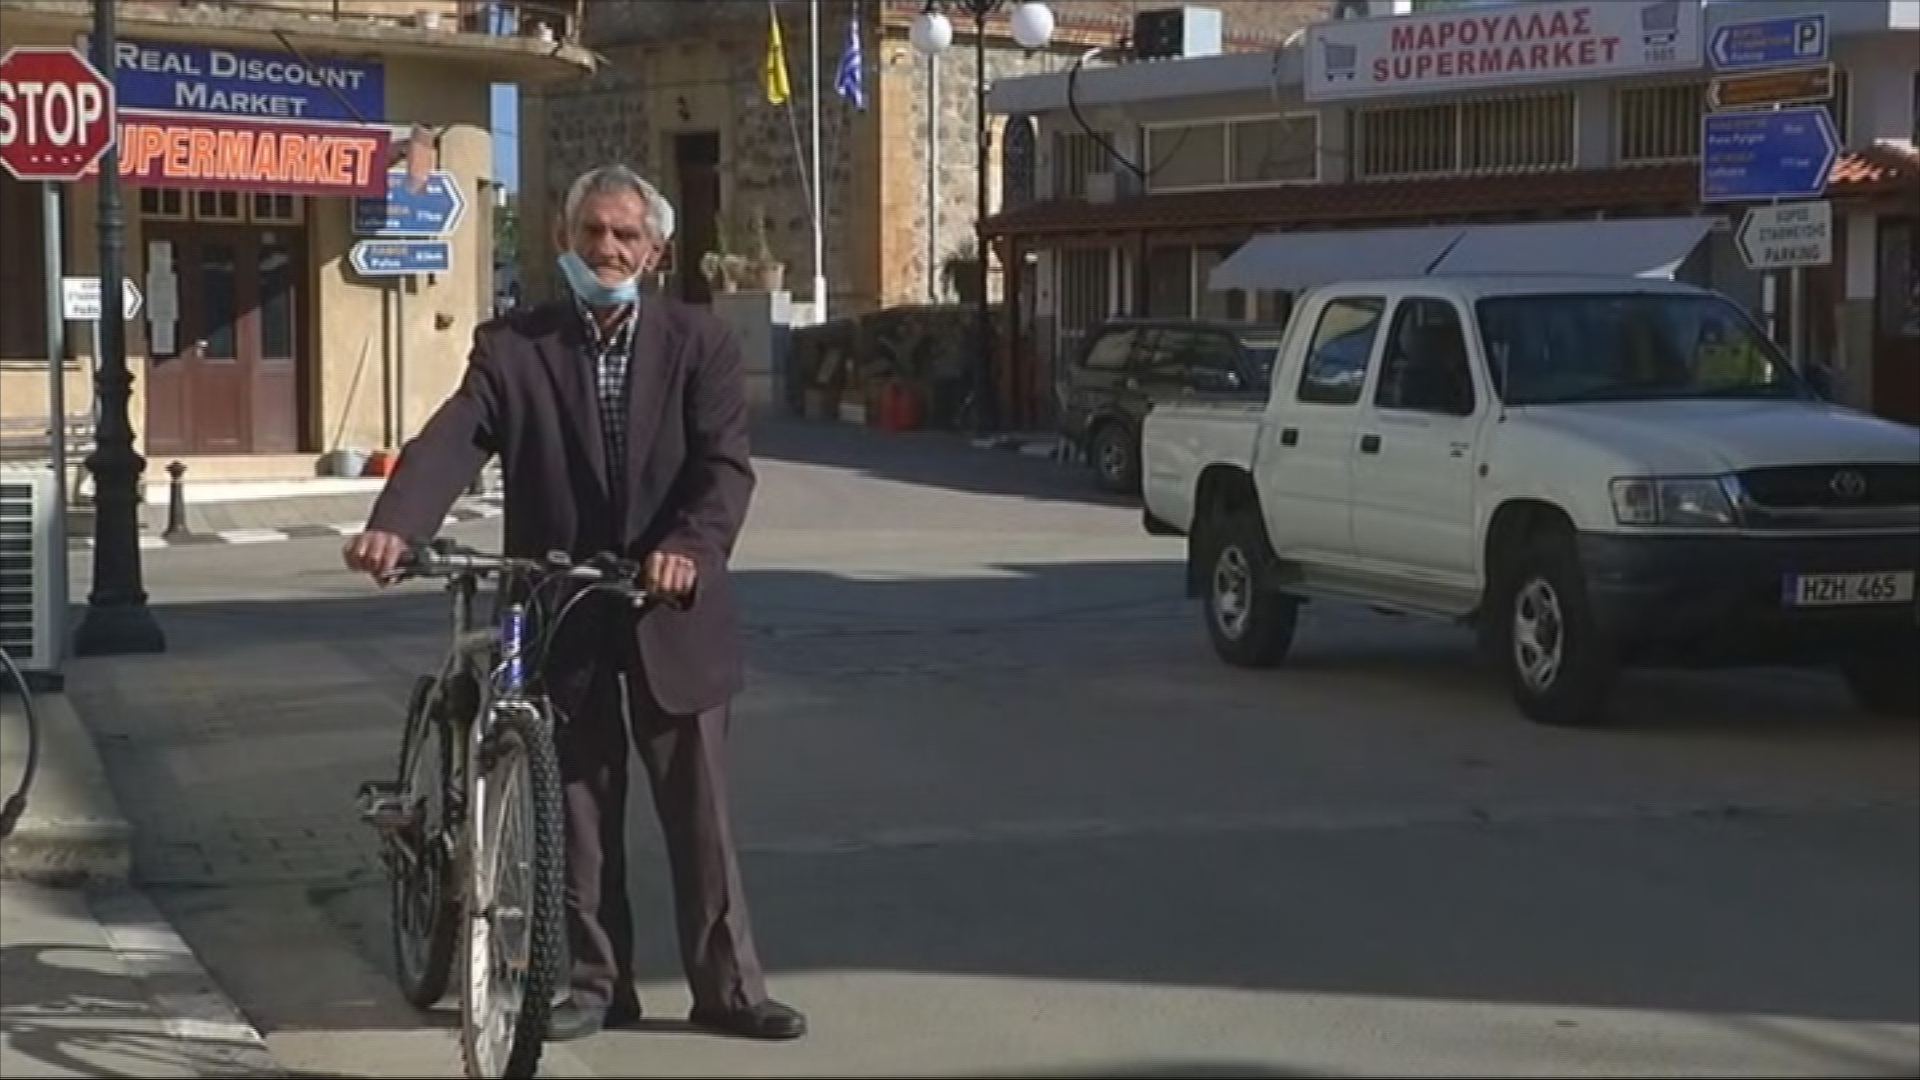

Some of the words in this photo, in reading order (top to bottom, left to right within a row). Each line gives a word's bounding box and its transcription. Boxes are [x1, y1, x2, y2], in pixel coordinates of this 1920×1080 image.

[1390, 8, 1592, 53] ΜΑΡΟΥΛΛΑΣ
[1800, 24, 1817, 52] P
[1372, 36, 1621, 82] SUPERMARKET
[0, 80, 103, 147] STOP
[1764, 244, 1820, 262] PARKING
[1804, 578, 1847, 601] HZH
[1856, 576, 1896, 599] 465
